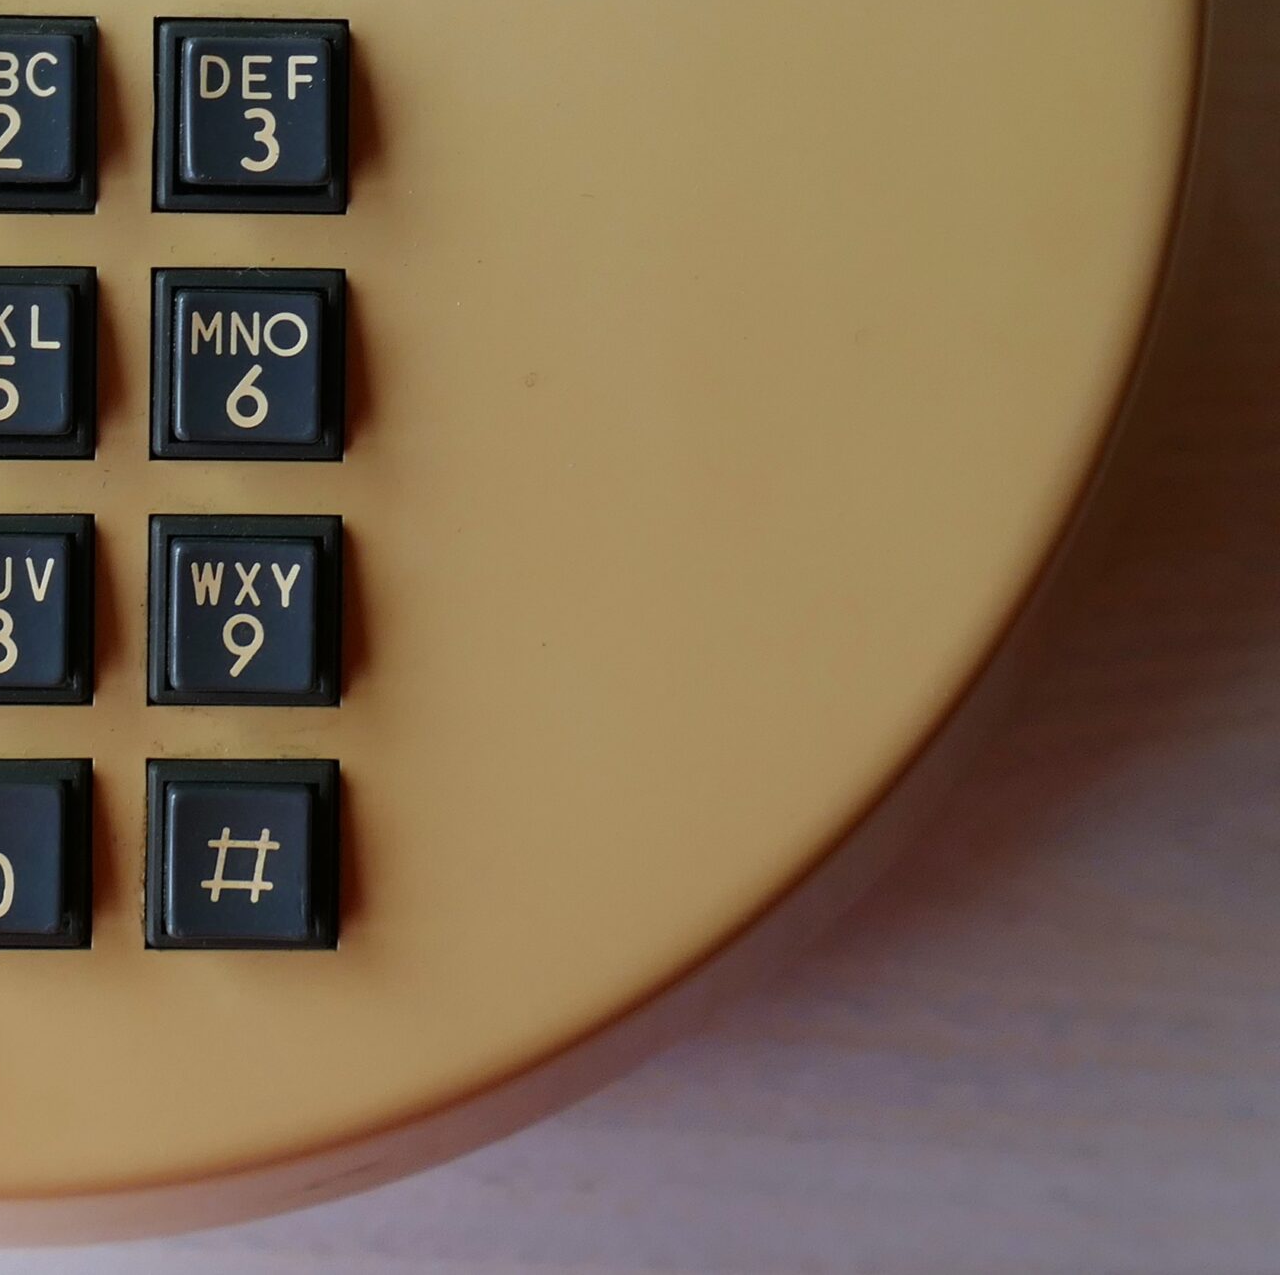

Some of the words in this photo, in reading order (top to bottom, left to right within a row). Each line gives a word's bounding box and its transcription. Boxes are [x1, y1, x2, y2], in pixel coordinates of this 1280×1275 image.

[200, 55, 318, 100] DEF
[240, 107, 280, 172] 3
[190, 311, 309, 357] MNO
[226, 364, 269, 428] 6
[191, 562, 301, 608] WXY
[222, 613, 265, 678] 9
